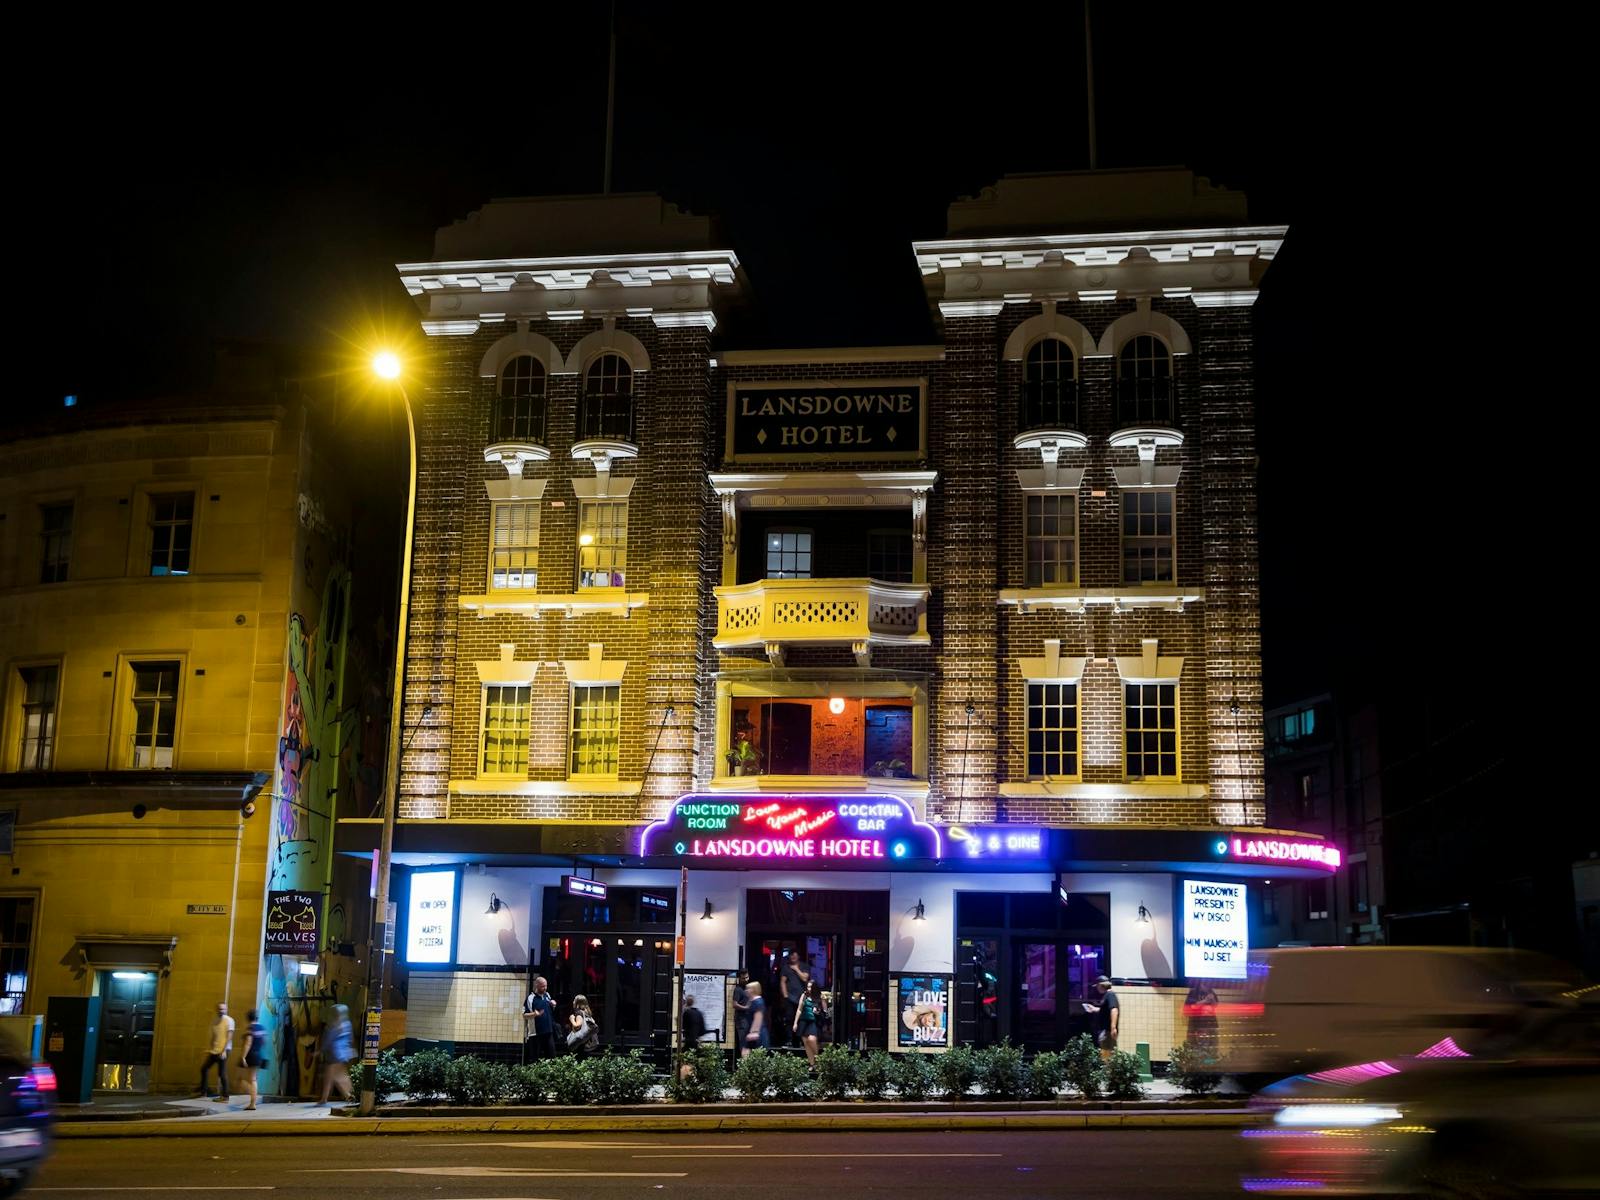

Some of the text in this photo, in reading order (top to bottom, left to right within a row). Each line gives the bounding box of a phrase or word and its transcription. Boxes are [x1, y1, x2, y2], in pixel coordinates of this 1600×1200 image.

[742, 394, 913, 416] LANSDOWNE
[781, 425, 872, 446] HOTEL
[675, 804, 740, 815] FUNCTION
[839, 804, 903, 817] COCKTAIL
[687, 818, 727, 829] ROOM
[793, 810, 836, 838] Music
[857, 818, 886, 831] BAR
[693, 839, 884, 857] LANSDOWNE HOTEL
[1007, 835, 1040, 849] DINE
[1190, 884, 1239, 897] LANSDOWNE
[274, 895, 312, 905] THE TWO
[1194, 898, 1235, 910] PRESENTS
[1193, 912, 1231, 922] MY DISCO
[266, 932, 316, 942] WOLVES
[1203, 938, 1244, 949] MANSIONS
[1203, 951, 1231, 961] DJ SET
[914, 990, 947, 1007] LOVE
[913, 1025, 947, 1042] BUZZ
